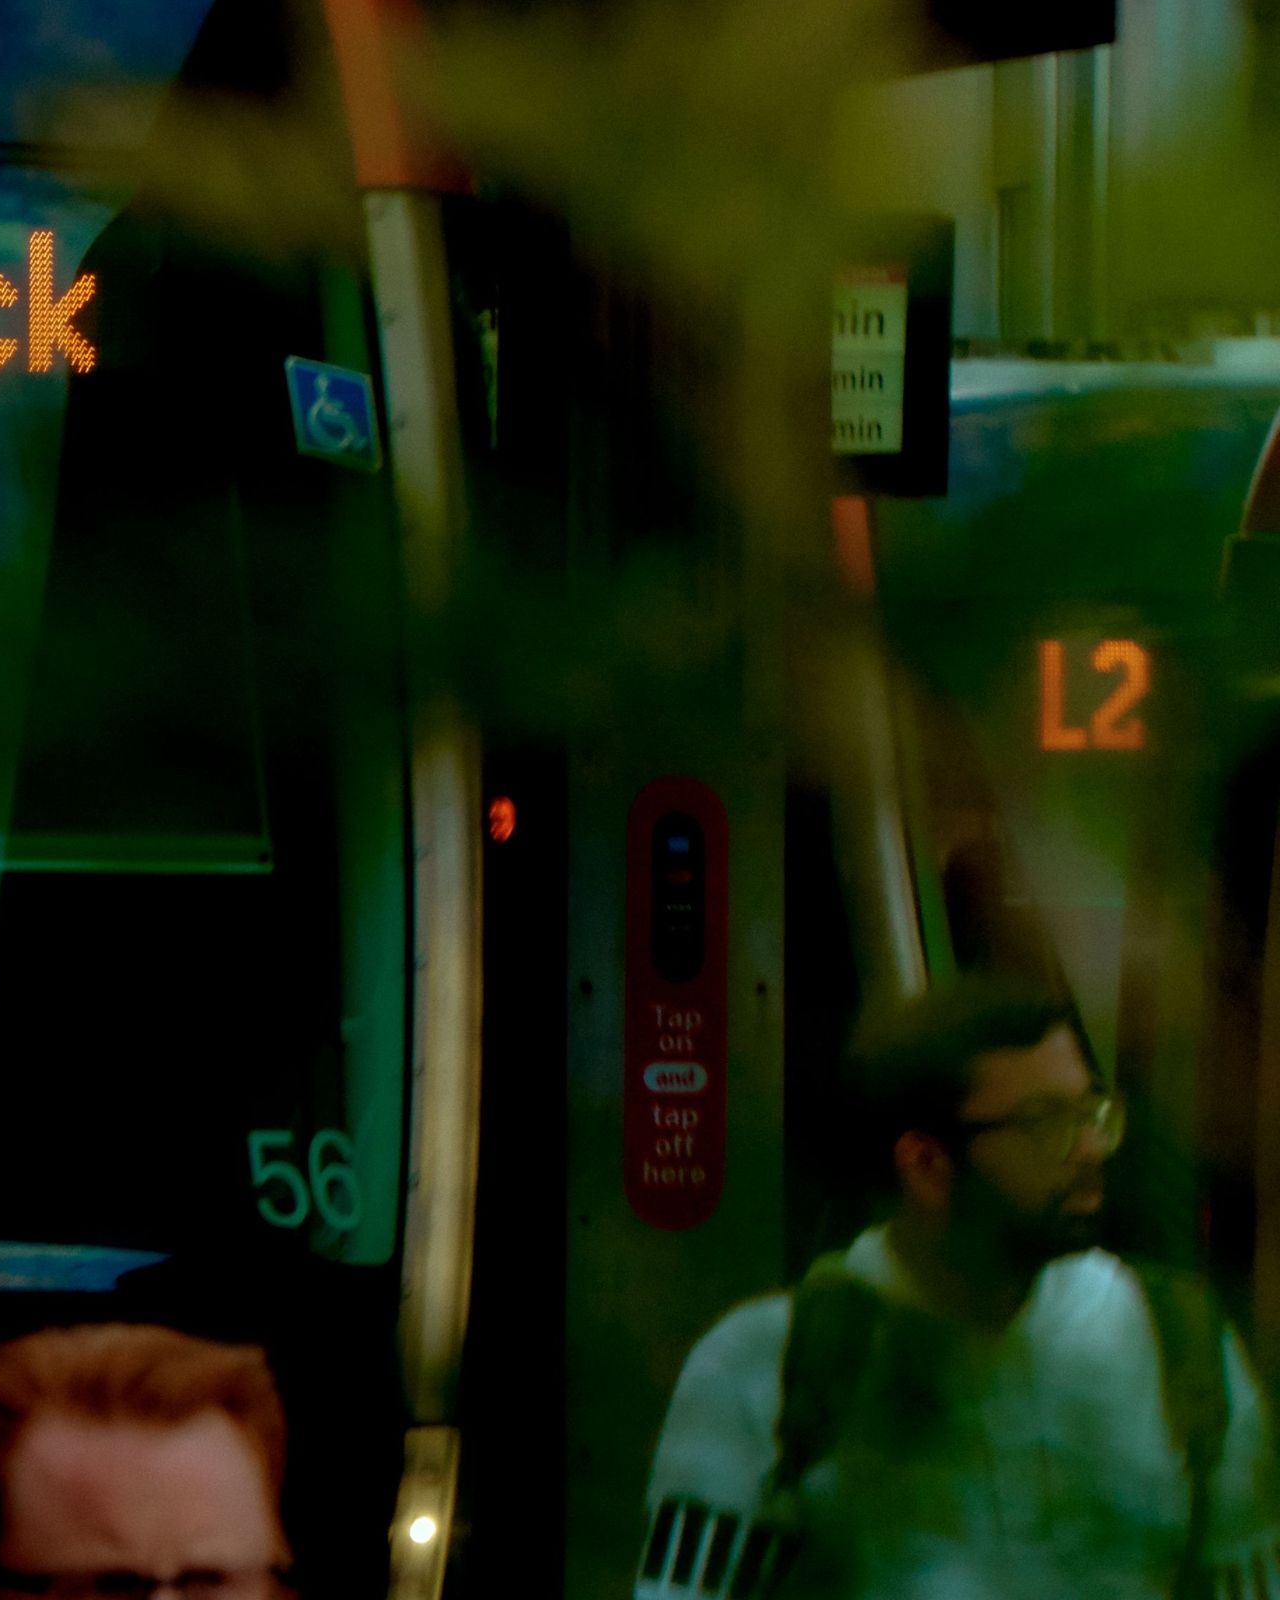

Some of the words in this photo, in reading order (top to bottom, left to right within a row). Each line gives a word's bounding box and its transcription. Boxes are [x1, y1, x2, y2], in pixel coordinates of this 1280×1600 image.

[1039, 639, 1150, 752] L2
[651, 1004, 704, 1032] Tap
[658, 1032, 695, 1053] on
[655, 1068, 697, 1089] and
[652, 1102, 700, 1132] tap
[654, 1132, 695, 1159] off
[246, 1128, 362, 1230] 56
[642, 1158, 707, 1185] here
